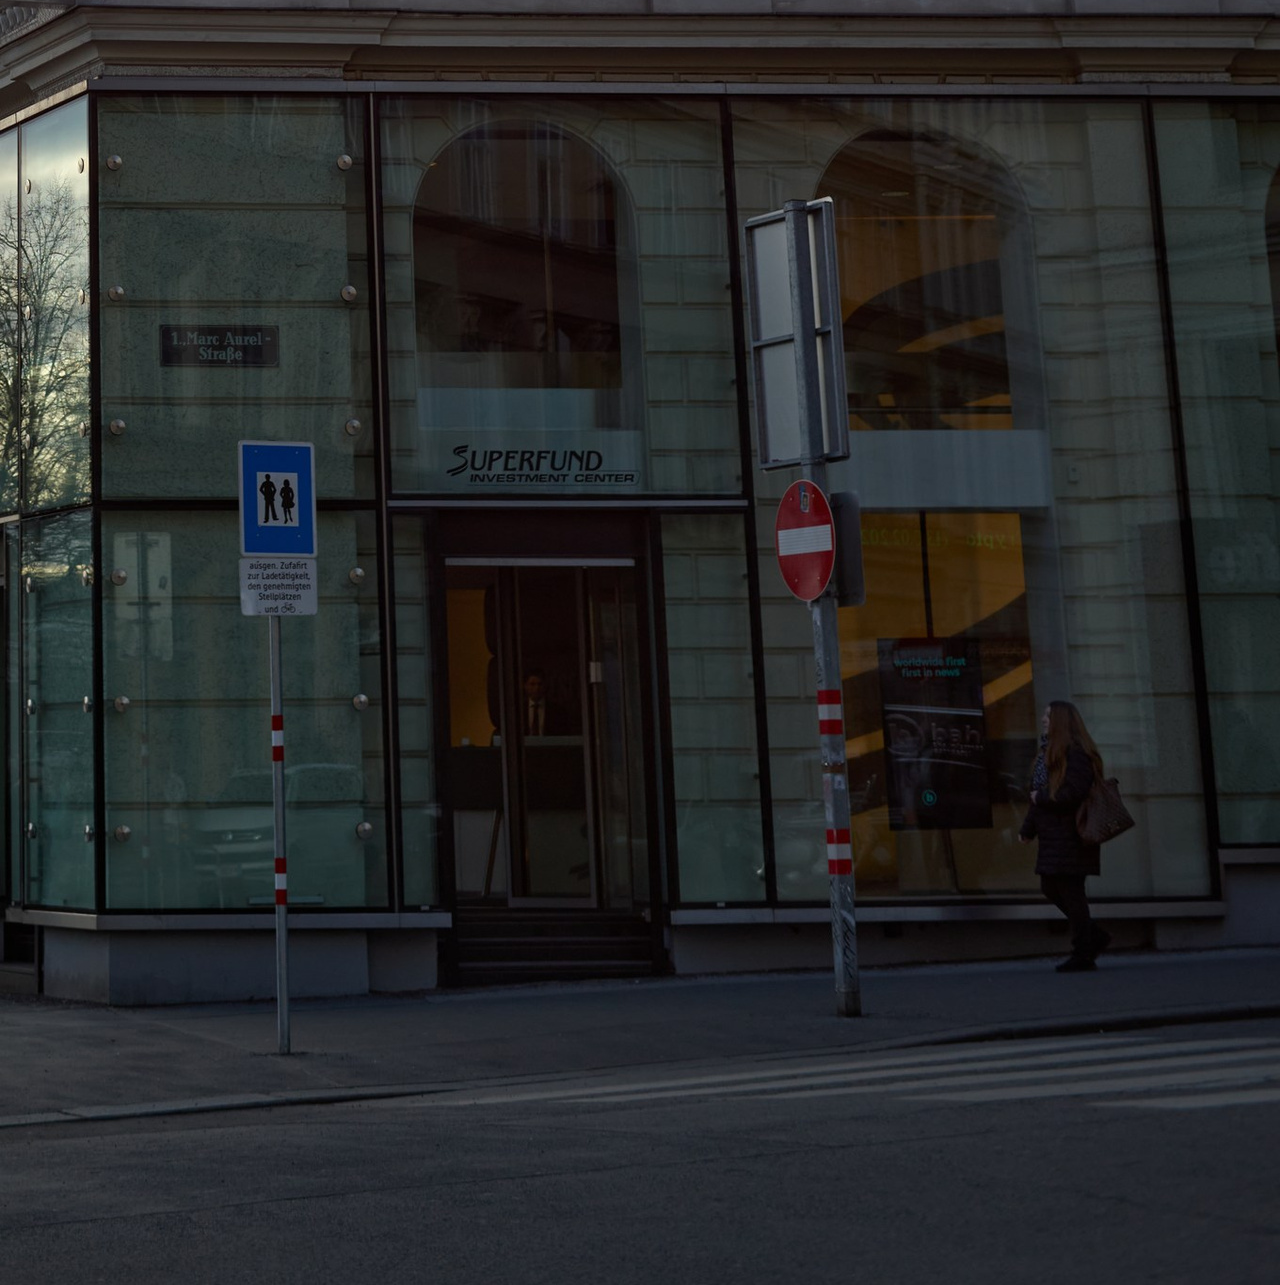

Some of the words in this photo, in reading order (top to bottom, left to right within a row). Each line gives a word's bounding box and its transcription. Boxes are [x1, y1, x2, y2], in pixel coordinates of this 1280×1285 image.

[199, 346, 243, 364] Straße
[446, 445, 603, 476] SUPERFUND
[470, 474, 569, 483] INVESTMENT
[574, 474, 635, 483] CENTER
[249, 562, 278, 571] ausgen.
[280, 561, 307, 570] Zufahrt
[261, 572, 310, 581] Ladetätigkeit,
[247, 582, 261, 590] den
[263, 582, 311, 591] genehmigten
[258, 592, 301, 601] Stellplätzen
[264, 605, 279, 613] und
[894, 657, 944, 667] worldwide
[946, 655, 966, 667] first
[901, 668, 921, 677] first
[923, 668, 933, 677] in
[935, 669, 961, 677] news
